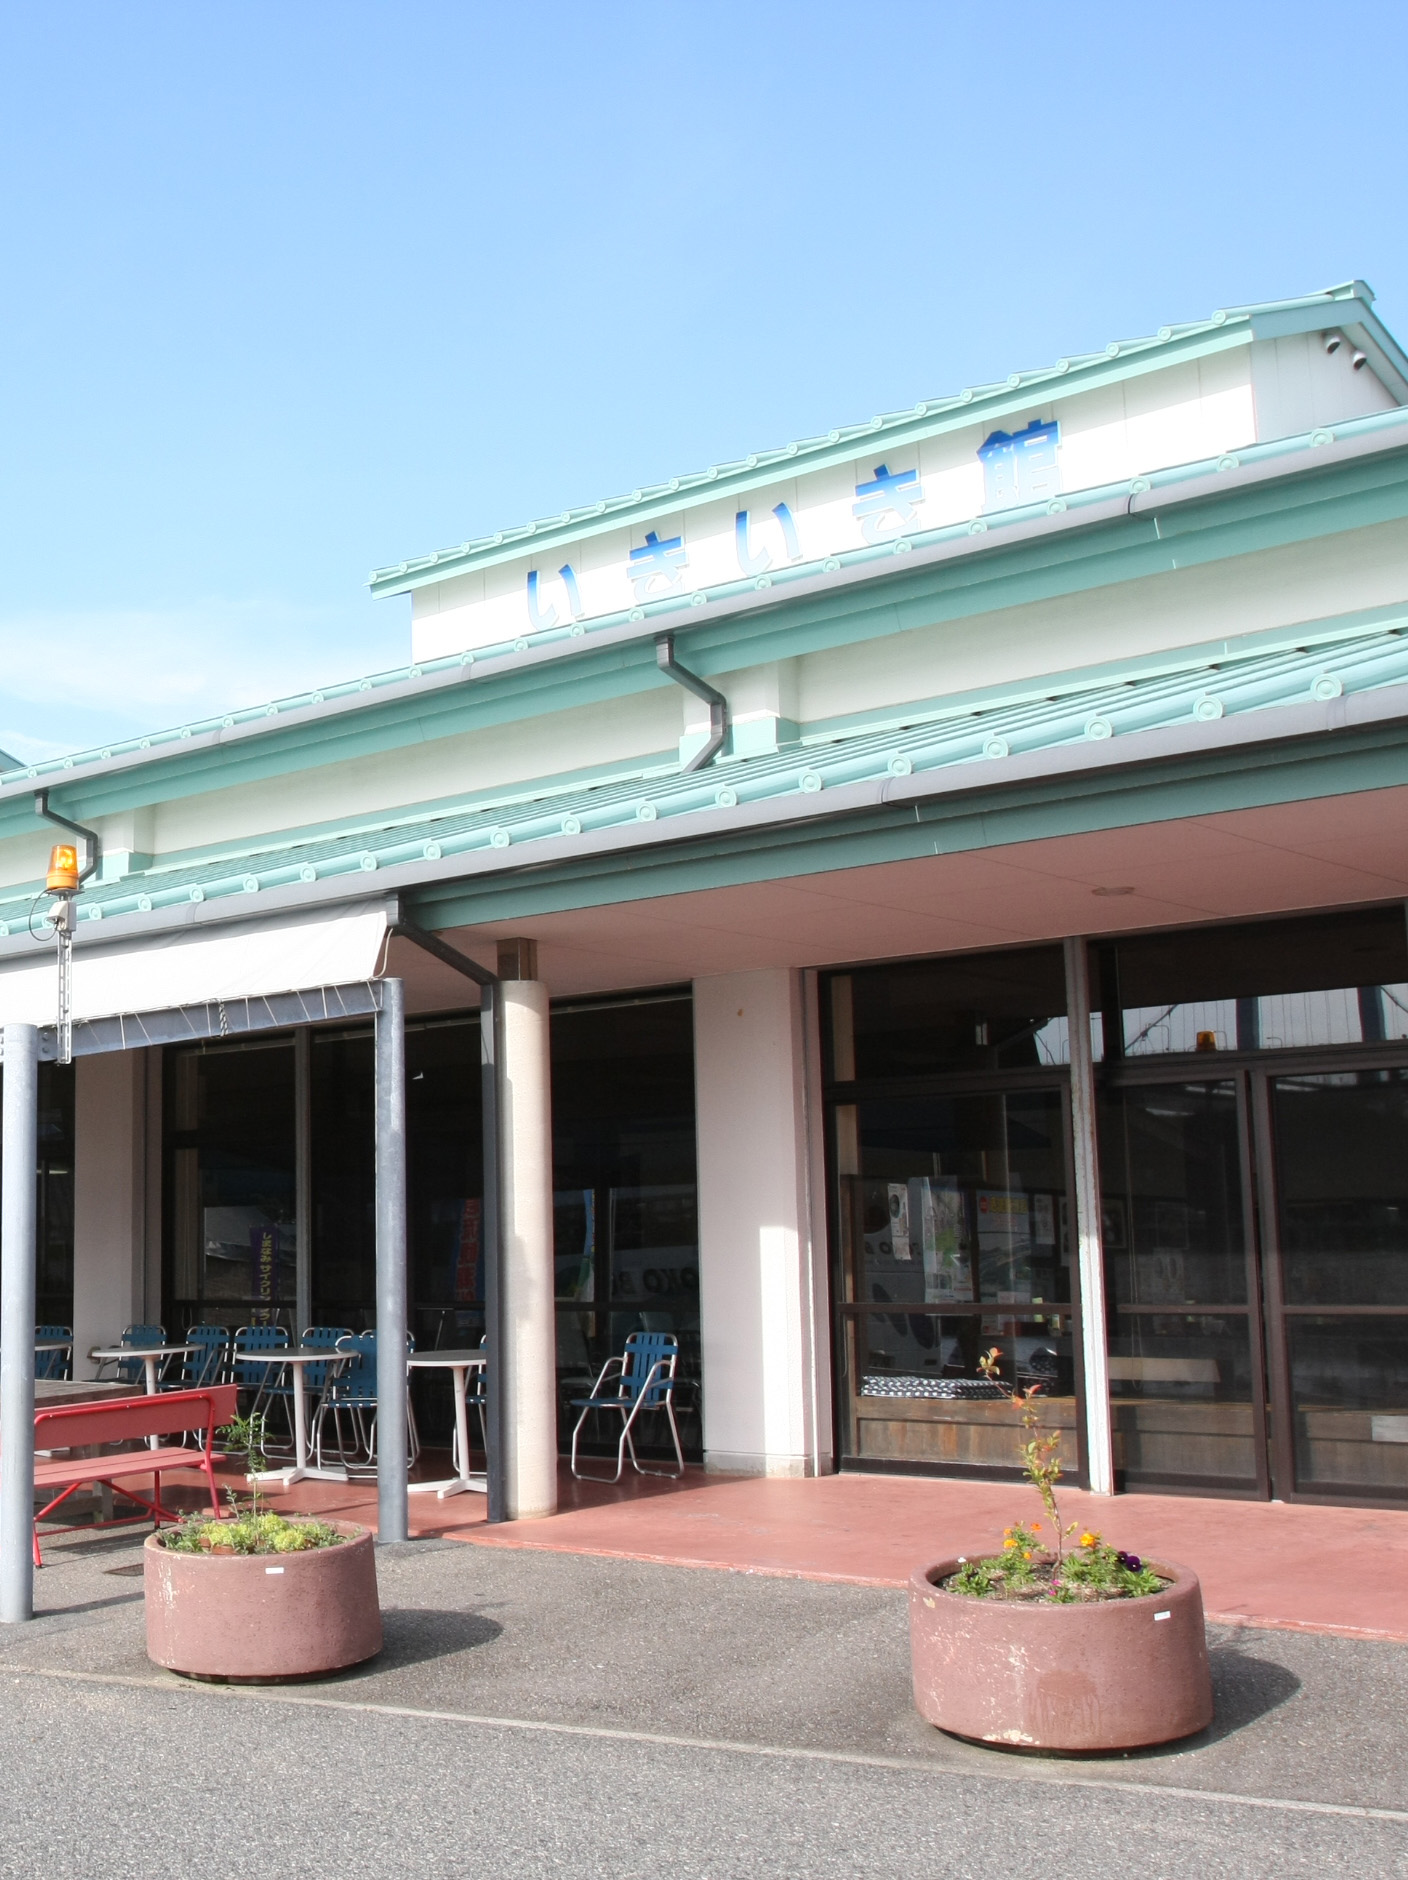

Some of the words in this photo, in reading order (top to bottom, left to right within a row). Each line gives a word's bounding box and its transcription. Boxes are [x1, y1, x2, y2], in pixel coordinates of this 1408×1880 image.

[526, 418, 1062, 632] いきいき館
